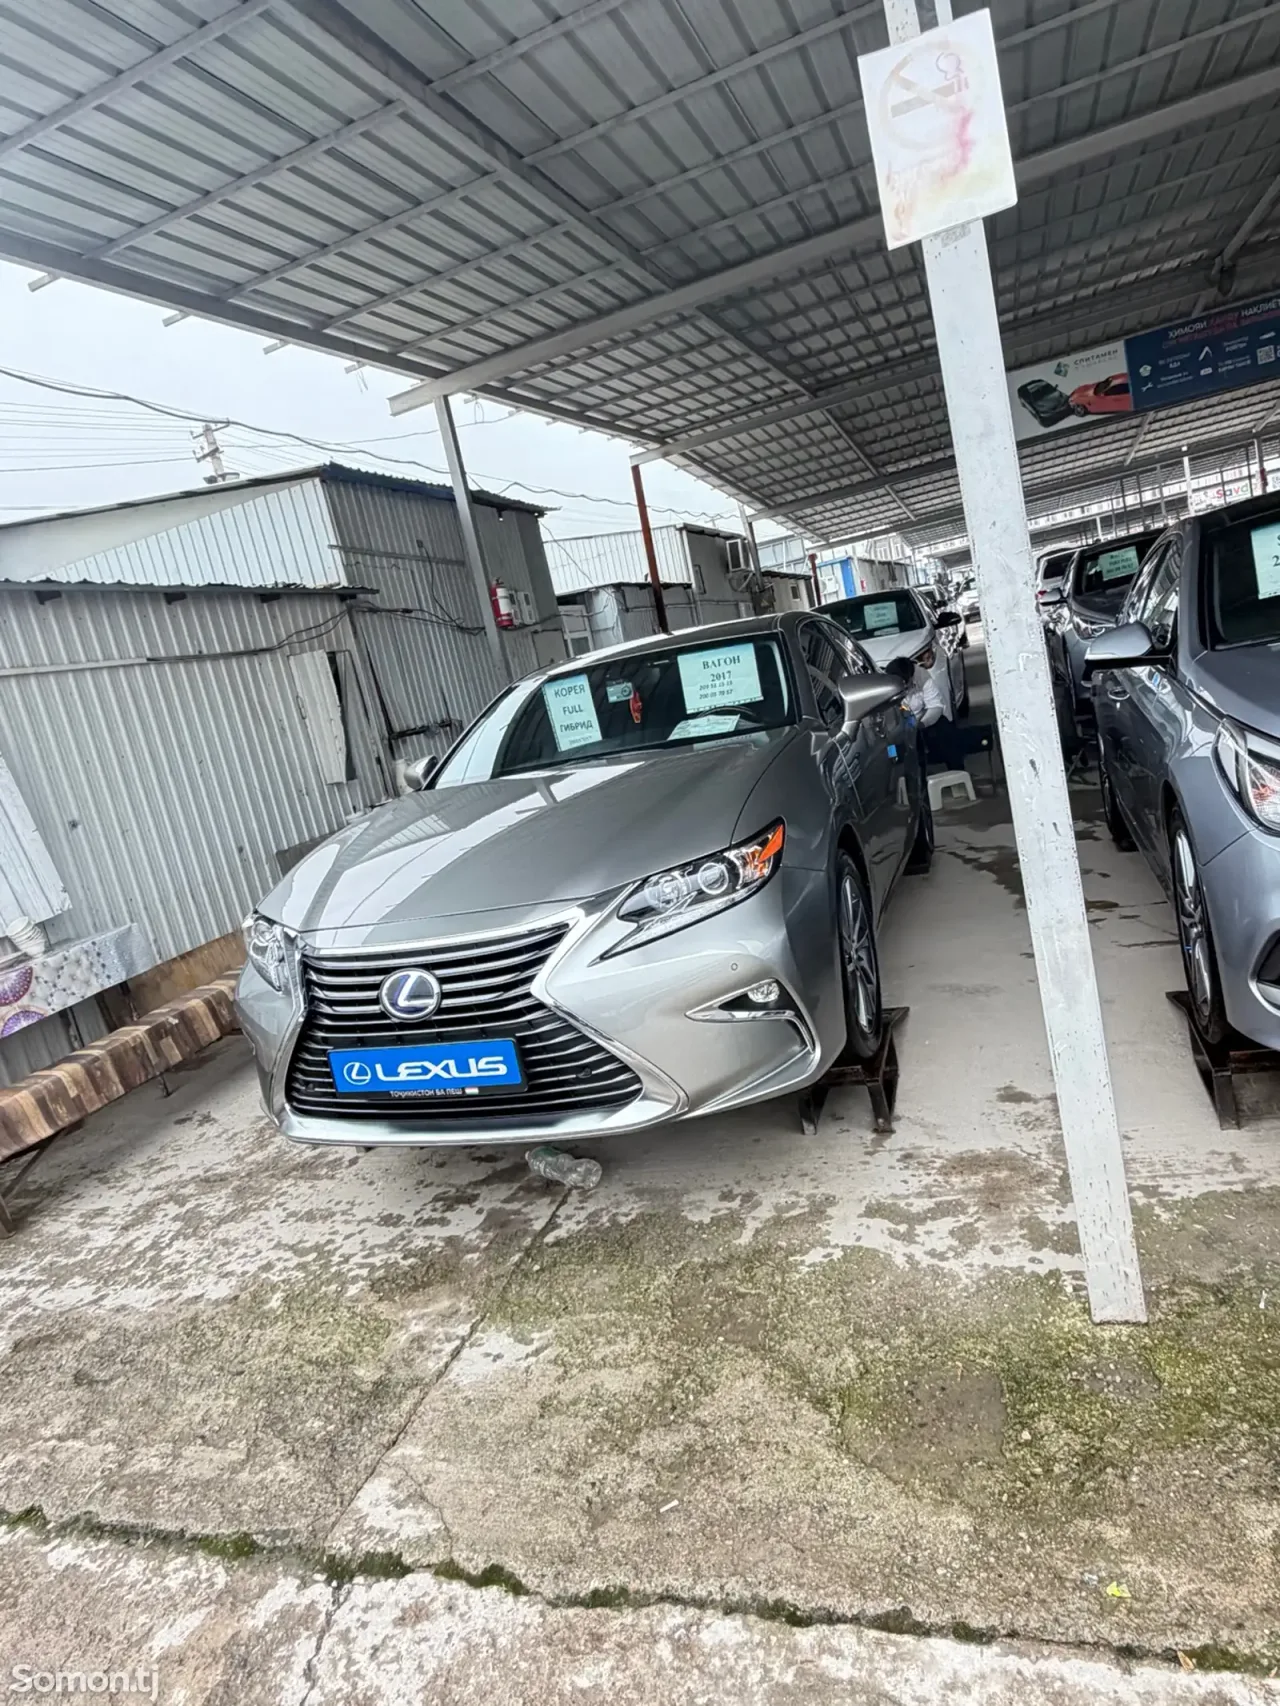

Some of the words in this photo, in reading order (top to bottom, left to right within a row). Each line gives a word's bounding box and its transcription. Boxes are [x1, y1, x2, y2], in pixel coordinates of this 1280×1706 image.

[702, 655, 741, 670] ВАГОН
[710, 670, 731, 682] 2017
[554, 684, 585, 698] КОРЕЯ
[562, 704, 584, 715] FULL
[560, 720, 593, 733] ГИБРИД
[374, 1056, 508, 1082] LEXUS
